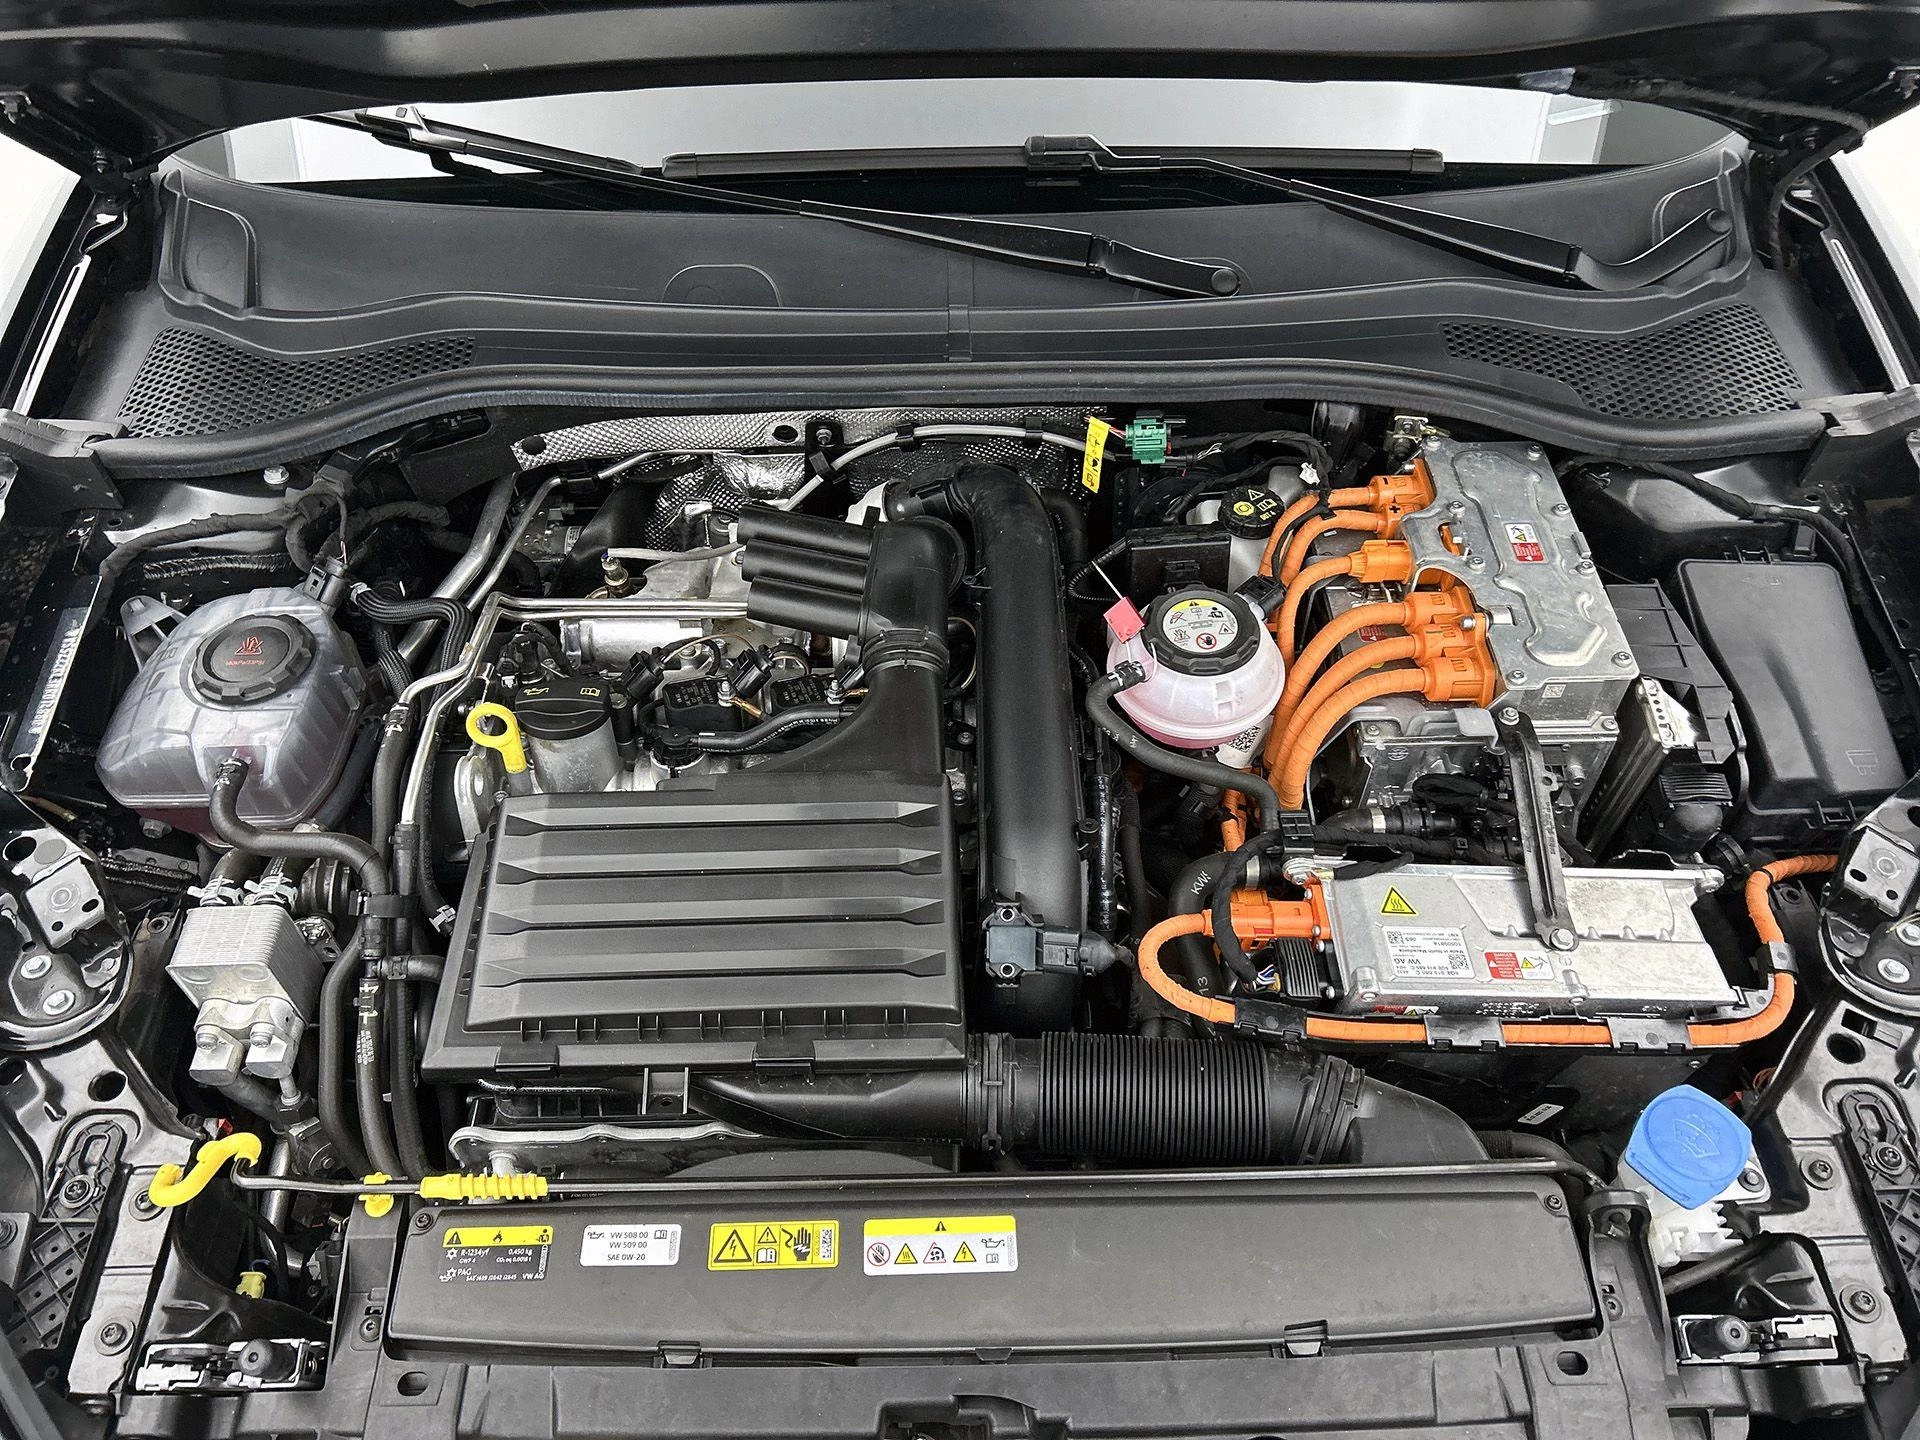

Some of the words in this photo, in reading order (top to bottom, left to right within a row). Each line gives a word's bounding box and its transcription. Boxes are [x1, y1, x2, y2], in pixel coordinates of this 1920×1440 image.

[610, 1231, 623, 1239] VW
[624, 1231, 638, 1239] 508
[638, 1231, 649, 1239] 00
[609, 1241, 622, 1249] VW
[622, 1241, 636, 1249] 509
[637, 1241, 648, 1249] 00
[460, 1247, 490, 1257] R-1234yf
[508, 1248, 525, 1256] 0.450
[524, 1248, 533, 1256] kg
[607, 1253, 621, 1261] SAE
[621, 1253, 646, 1261] 0W-20
[457, 1267, 472, 1276] PAG
[533, 1272, 545, 1280] AG
